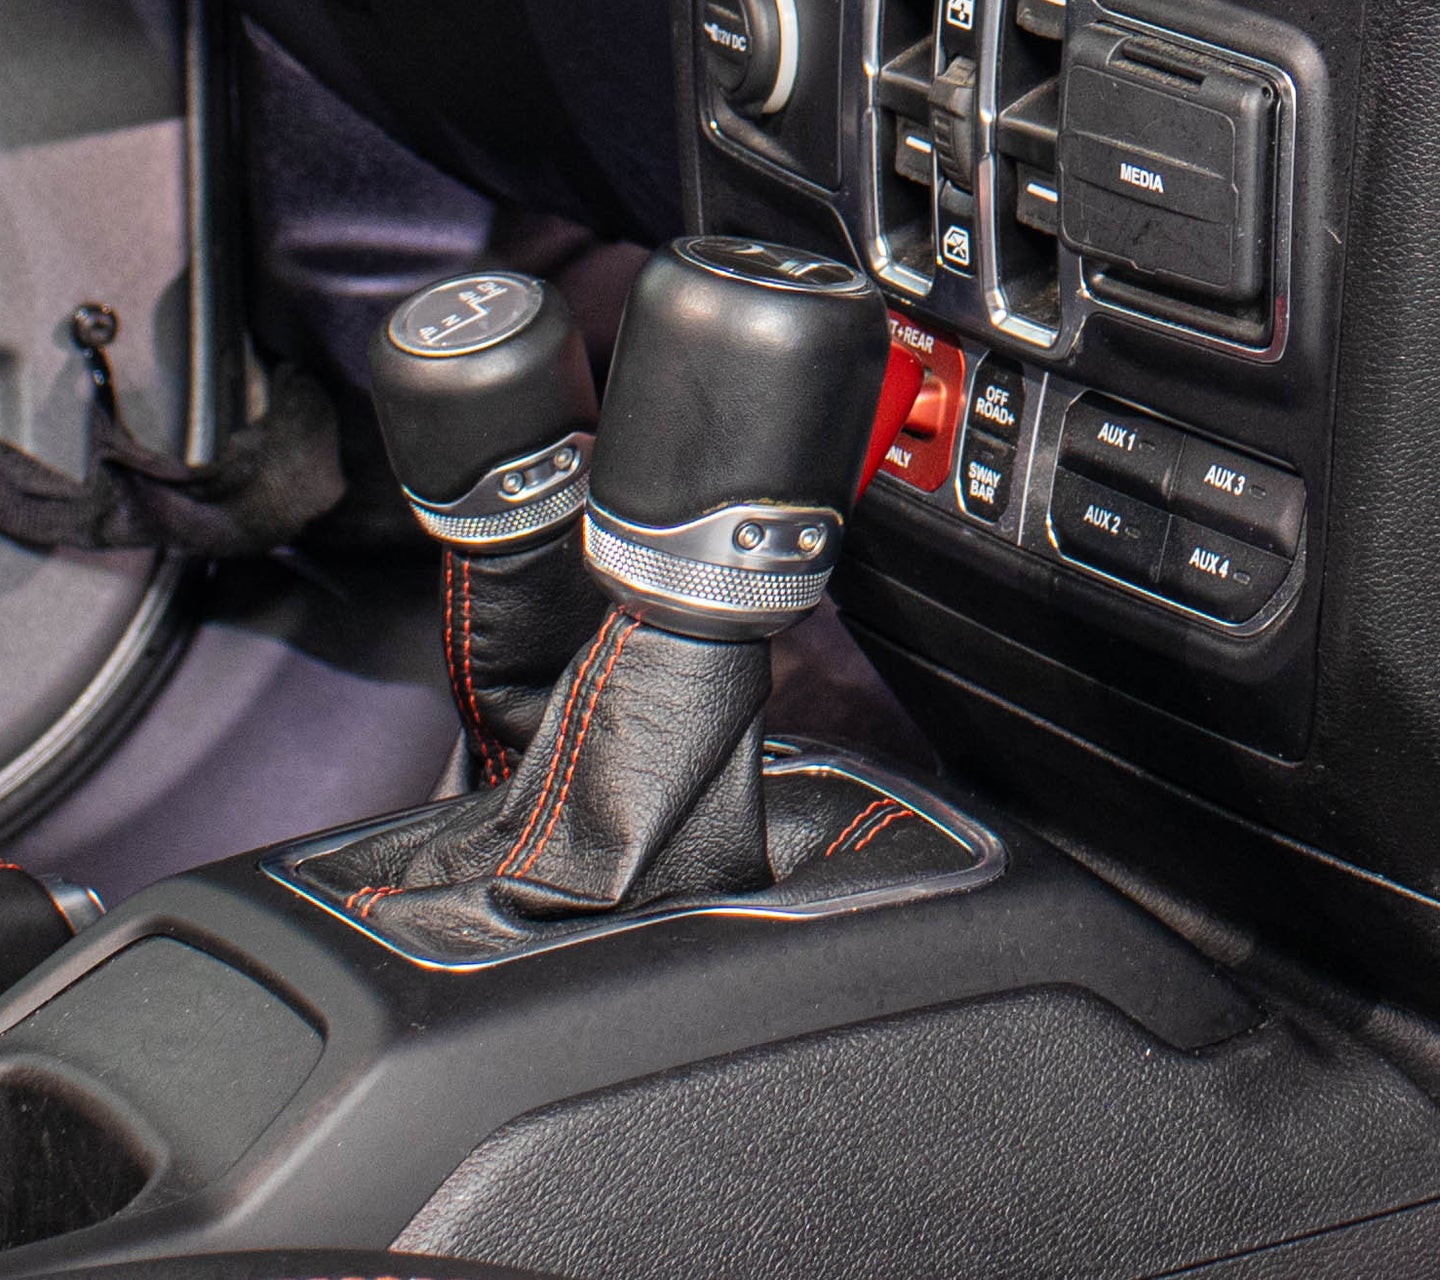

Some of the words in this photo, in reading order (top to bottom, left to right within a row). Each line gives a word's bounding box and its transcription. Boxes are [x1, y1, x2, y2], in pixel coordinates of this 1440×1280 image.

[731, 33, 747, 52] DC
[1120, 162, 1164, 194] MEDIA
[889, 318, 935, 355] T+REAR
[986, 384, 1010, 407] OFF
[975, 397, 1016, 426] ROAD+
[1097, 421, 1128, 449] AUX
[1127, 433, 1137, 452] 1
[968, 461, 1002, 489] SWAY
[1204, 464, 1235, 493] AUX
[1234, 475, 1247, 497] 3
[969, 482, 996, 505] BAR
[1083, 504, 1112, 531] AUX
[1111, 515, 1122, 536] 2
[1189, 547, 1220, 576] AUX
[1218, 558, 1231, 579] 4
